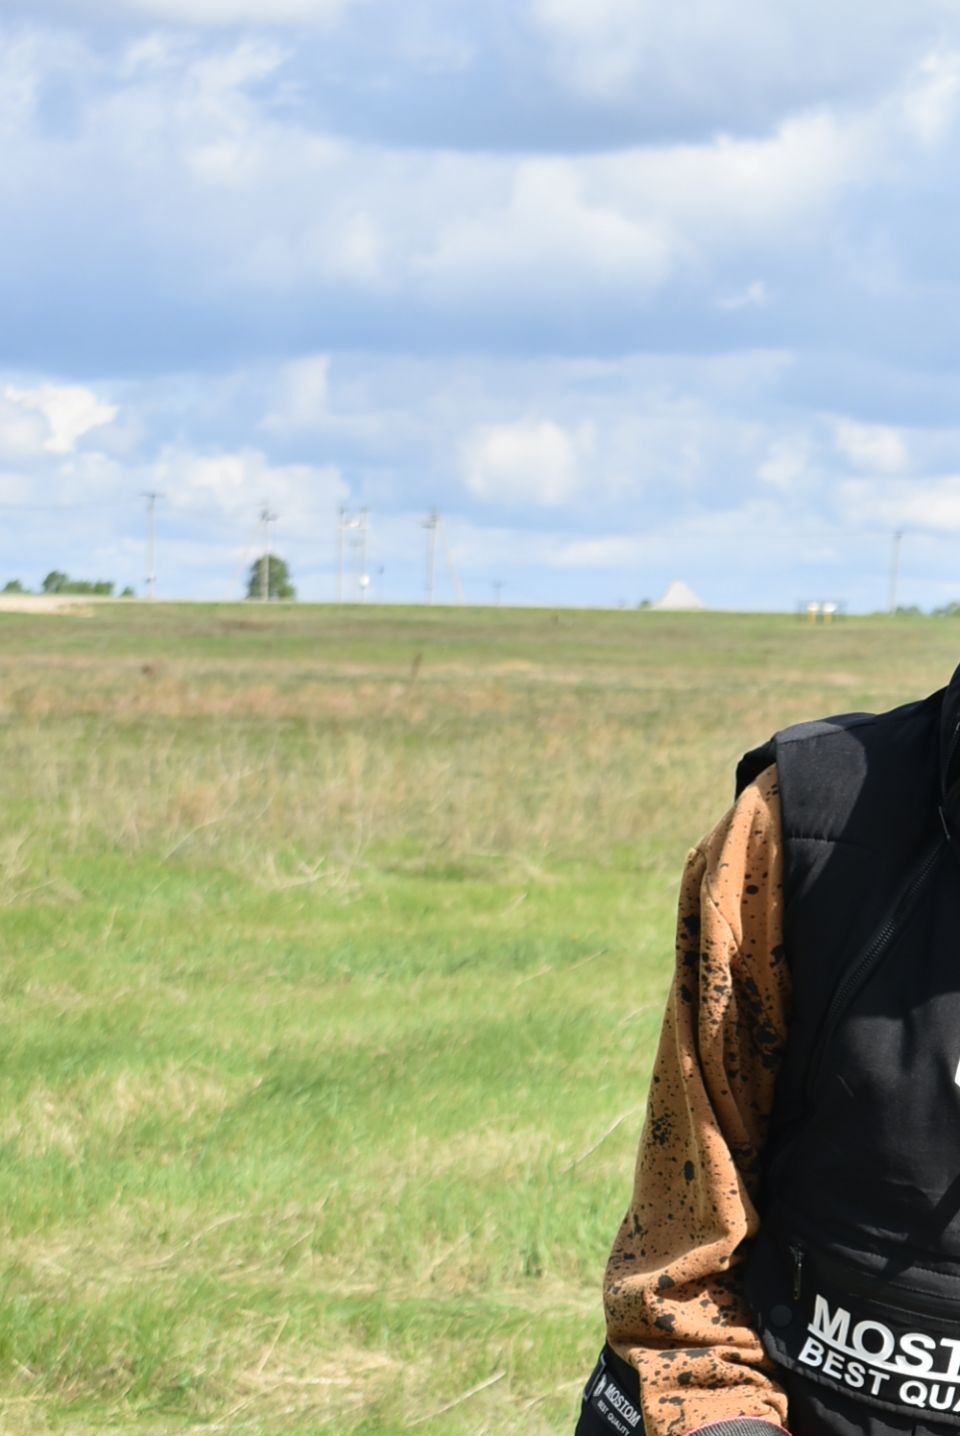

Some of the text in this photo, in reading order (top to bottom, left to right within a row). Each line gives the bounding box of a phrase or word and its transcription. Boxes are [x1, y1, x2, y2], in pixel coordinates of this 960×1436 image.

[798, 1336, 891, 1396] BEST
[604, 1383, 642, 1428] MOSTOM
[607, 1412, 631, 1436] QUALITY
